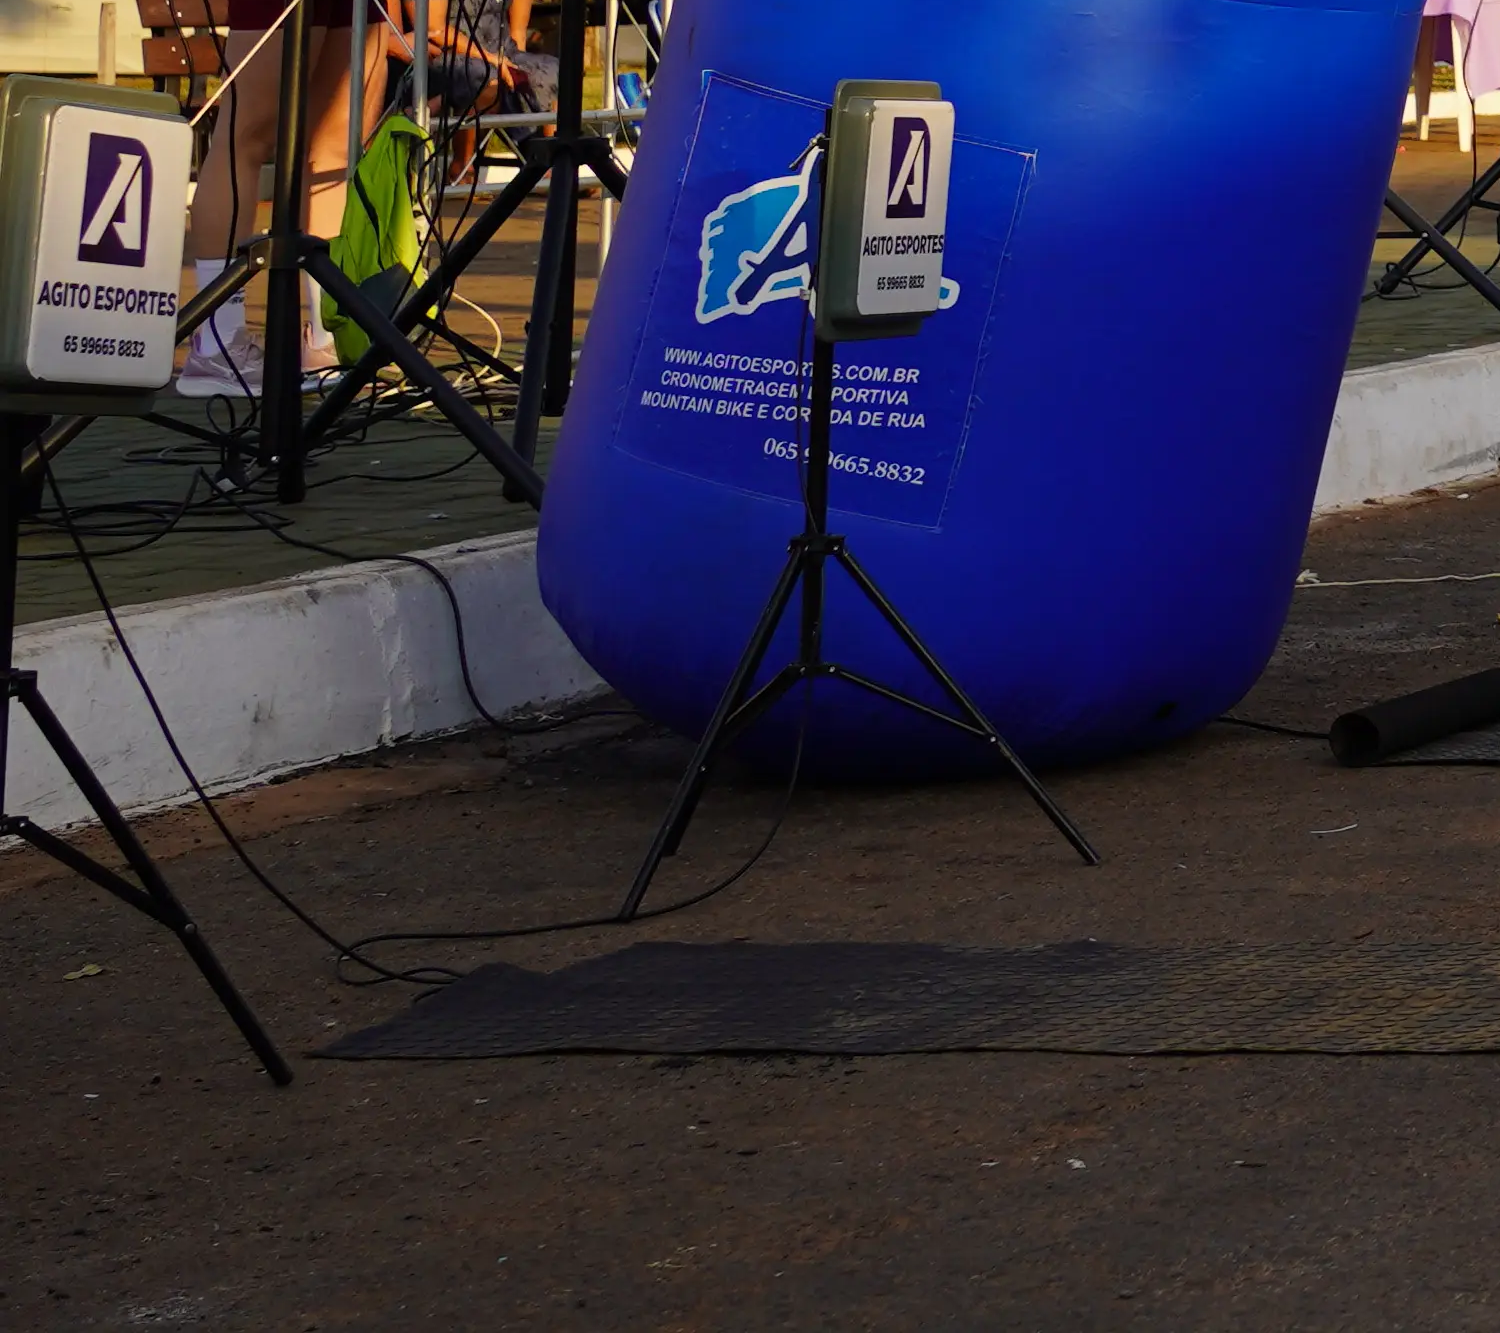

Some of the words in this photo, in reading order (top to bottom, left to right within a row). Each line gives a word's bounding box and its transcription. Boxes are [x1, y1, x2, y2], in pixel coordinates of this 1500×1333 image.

[863, 235, 894, 256] AGITO
[894, 234, 944, 255] ESPORTES
[38, 280, 91, 309] AGITO
[94, 285, 177, 317] ESPORTES
[63, 335, 79, 353] 65
[80, 336, 116, 356] 99665
[117, 340, 146, 358] 8832
[663, 346, 920, 384] WWW.AGITOESPORTS.COM.BR
[640, 390, 713, 414] MOUNTAIN
[715, 401, 753, 418] BIKE
[757, 404, 768, 419] E
[772, 405, 853, 426] CORDA
[858, 413, 882, 427] DE
[887, 412, 926, 429] RUA
[763, 437, 798, 461] 065
